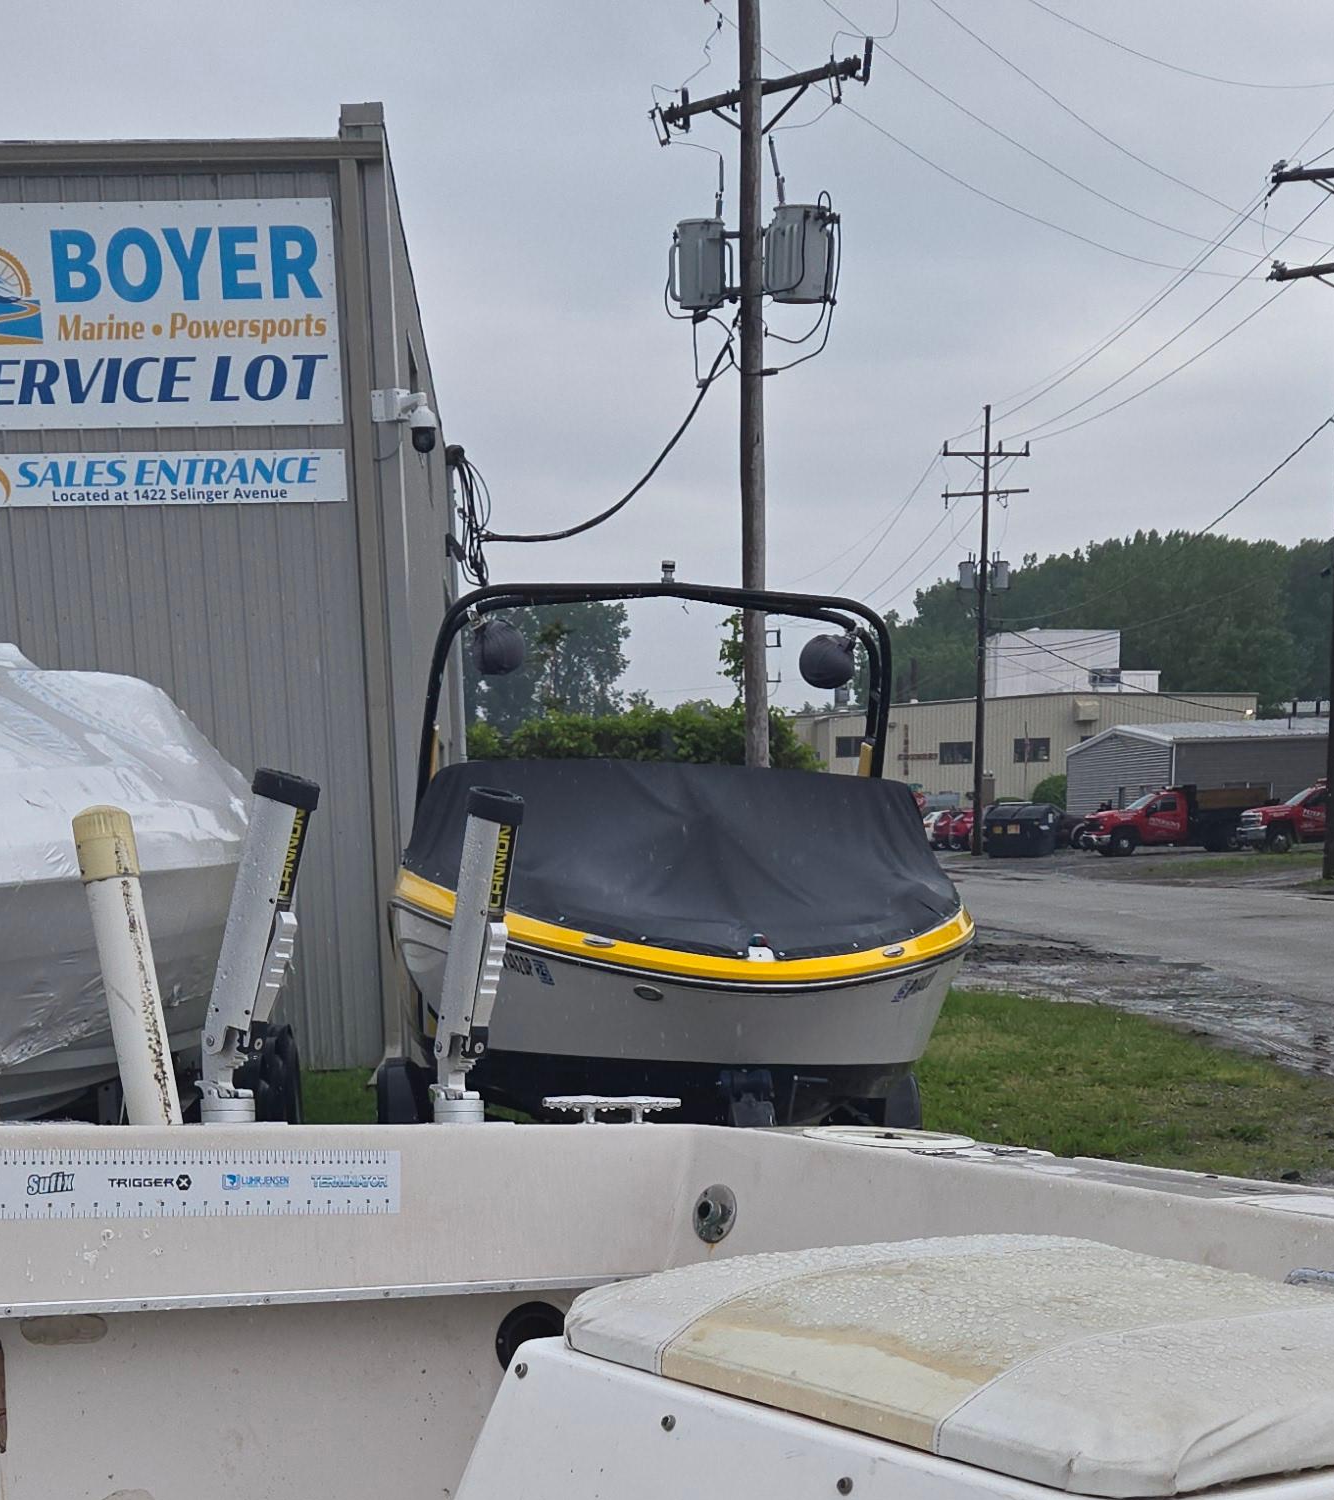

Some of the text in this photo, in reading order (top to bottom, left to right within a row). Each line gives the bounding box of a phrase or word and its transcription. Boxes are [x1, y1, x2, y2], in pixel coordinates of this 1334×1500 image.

[50, 226, 323, 303] BOYER
[58, 311, 327, 344] Marine Powersports
[210, 354, 328, 401] LOT
[16, 456, 320, 488] SALES ENTRANCE
[52, 487, 287, 502] Located at 1422 Selinger Avenue
[278, 808, 306, 896] CANNON
[489, 825, 512, 908] CANNON
[26, 1171, 75, 1195] Sufix
